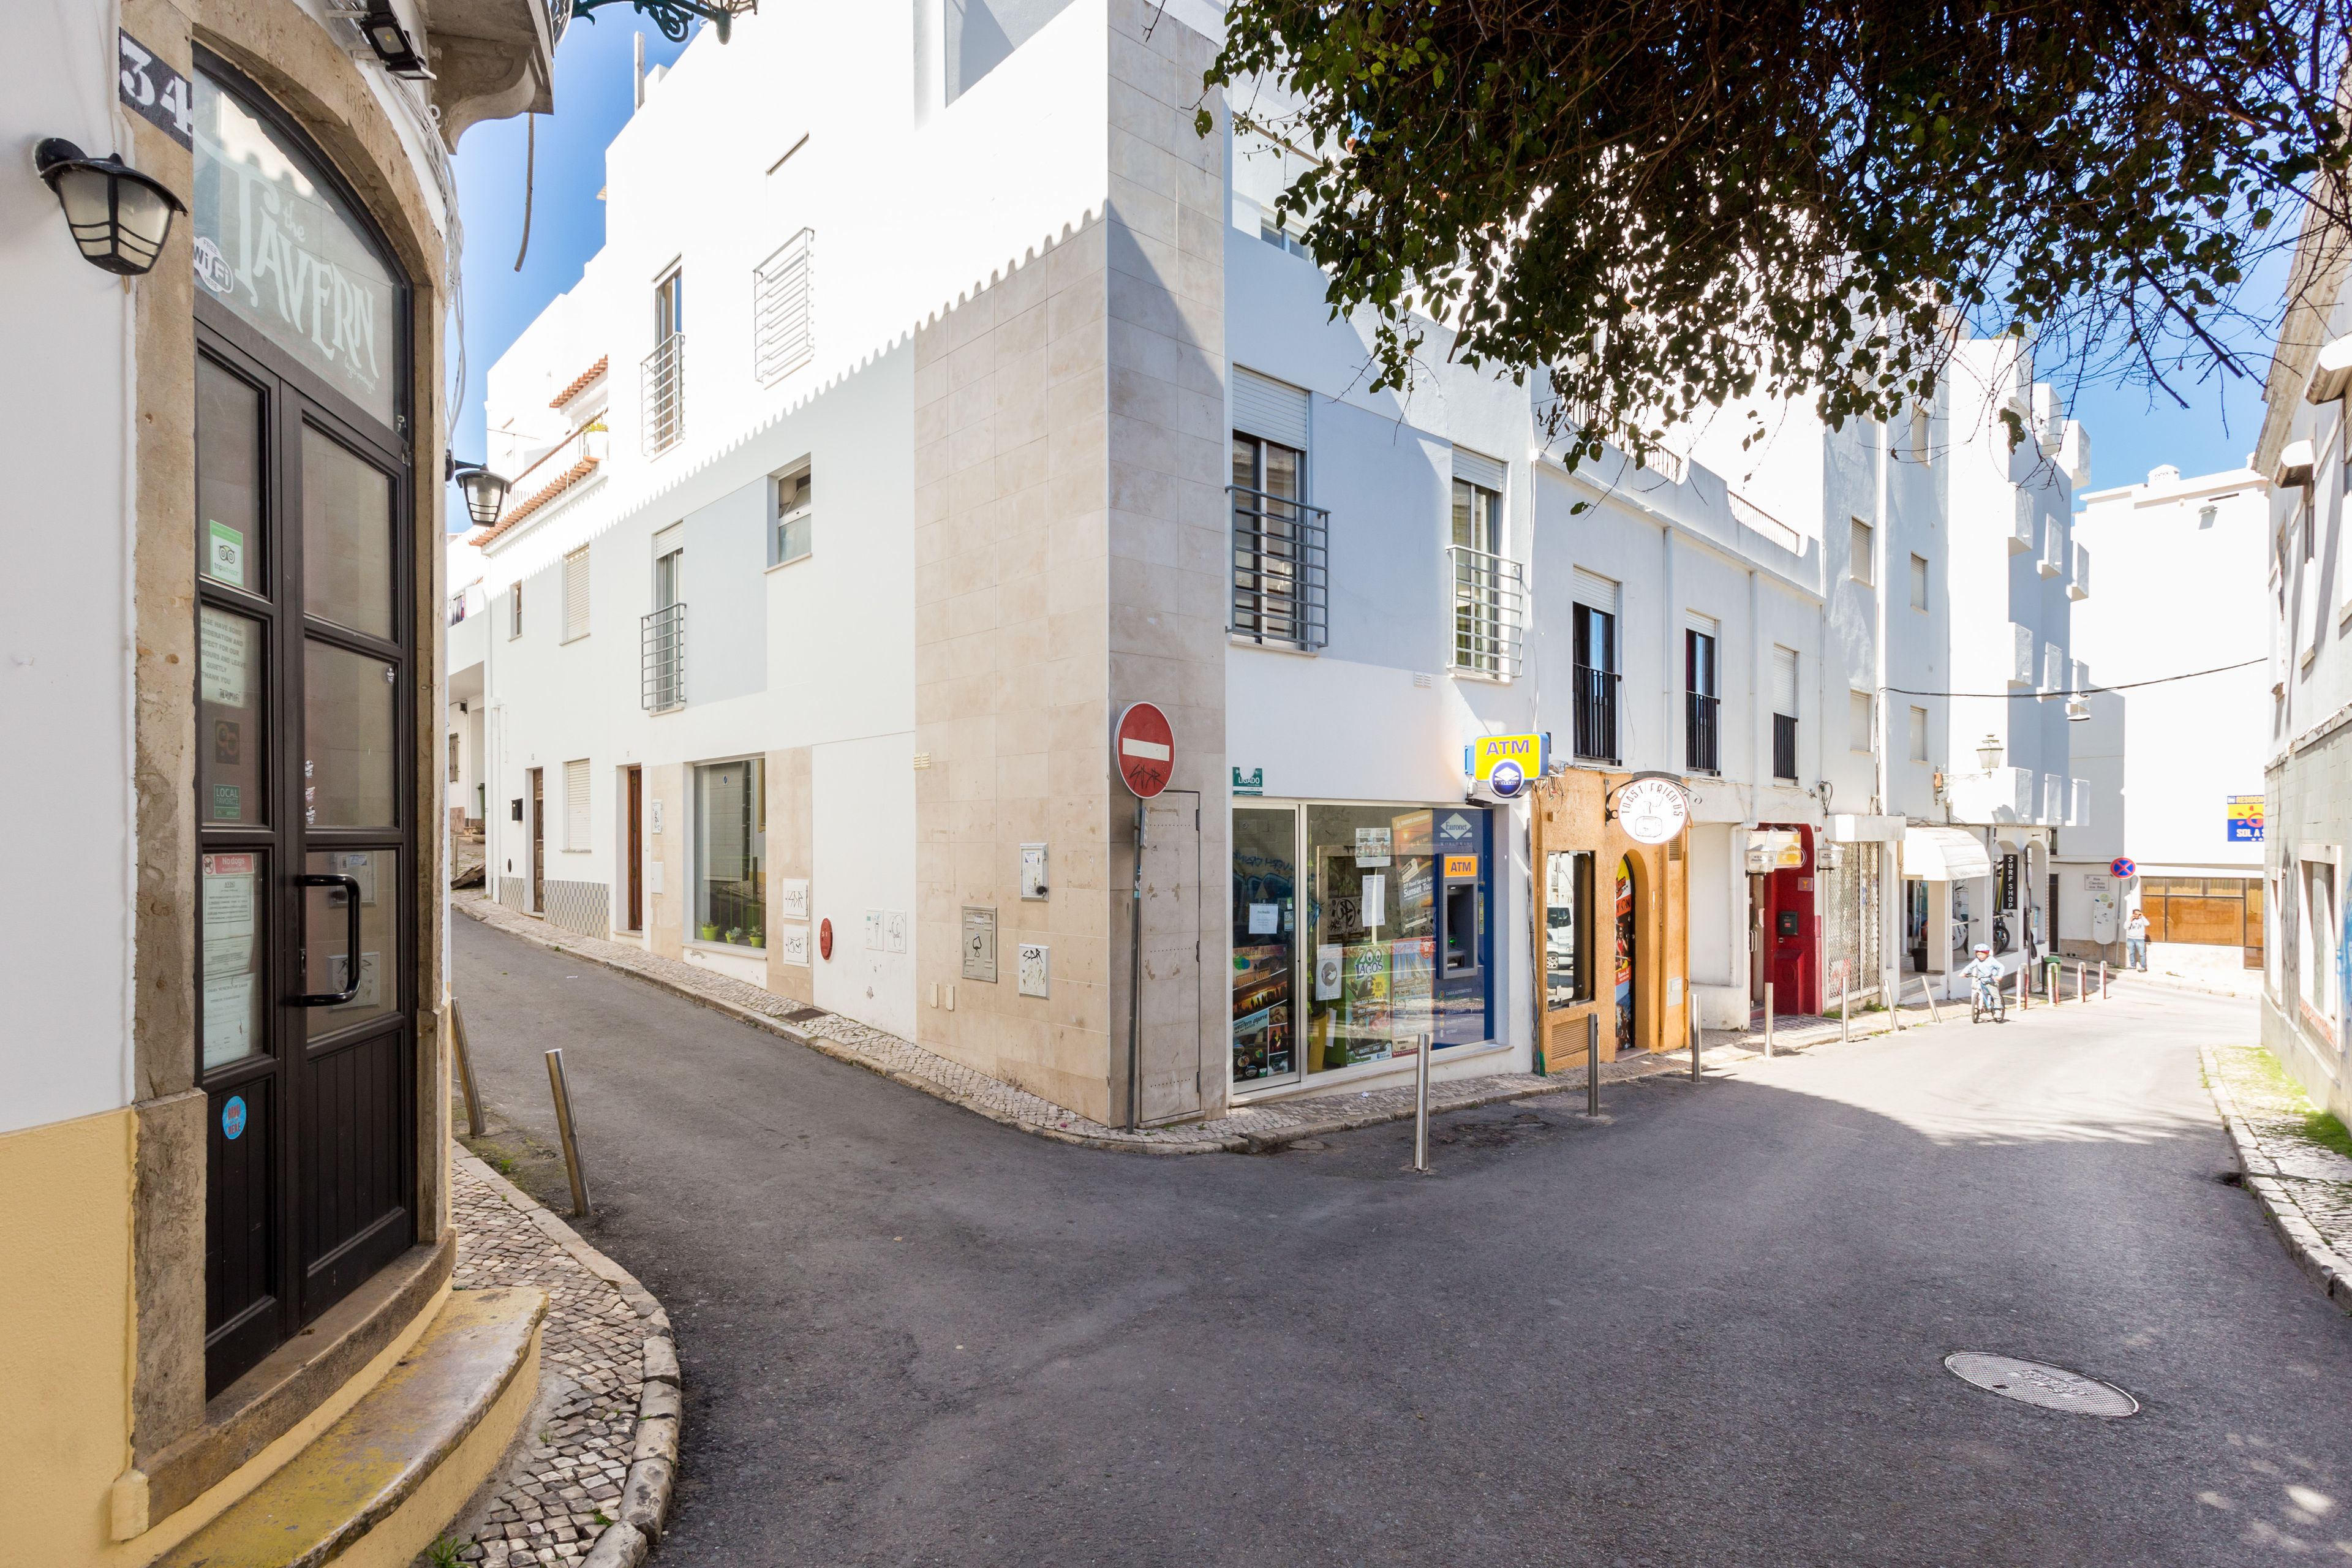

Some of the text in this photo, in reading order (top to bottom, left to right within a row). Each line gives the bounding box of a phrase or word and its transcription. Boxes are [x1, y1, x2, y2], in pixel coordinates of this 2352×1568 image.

[121, 36, 192, 137] 34
[282, 200, 305, 243] the
[193, 131, 379, 379] TAVERN
[203, 239, 219, 256] FREE
[214, 562, 239, 576] tripadvisor
[201, 627, 243, 647] SIDERATION AND
[206, 662, 227, 673] QUIETLY
[221, 676, 231, 685] YOU
[1486, 739, 1529, 755] ATM
[216, 788, 238, 798] LOCAL
[1621, 783, 1684, 816] TOAST FRIENDS
[1446, 821, 1468, 831] Euronet
[2236, 829, 2253, 837] SOL
[231, 858, 245, 866] dogs
[1450, 862, 1472, 872] ATM
[1403, 886, 1421, 897] Sunset
[1423, 883, 1433, 891] Tou
[1355, 946, 1383, 965] ZOO
[1355, 960, 1383, 979] LAGOS
[1234, 1019, 1253, 1031] western
[1253, 1014, 1268, 1025] algarve
